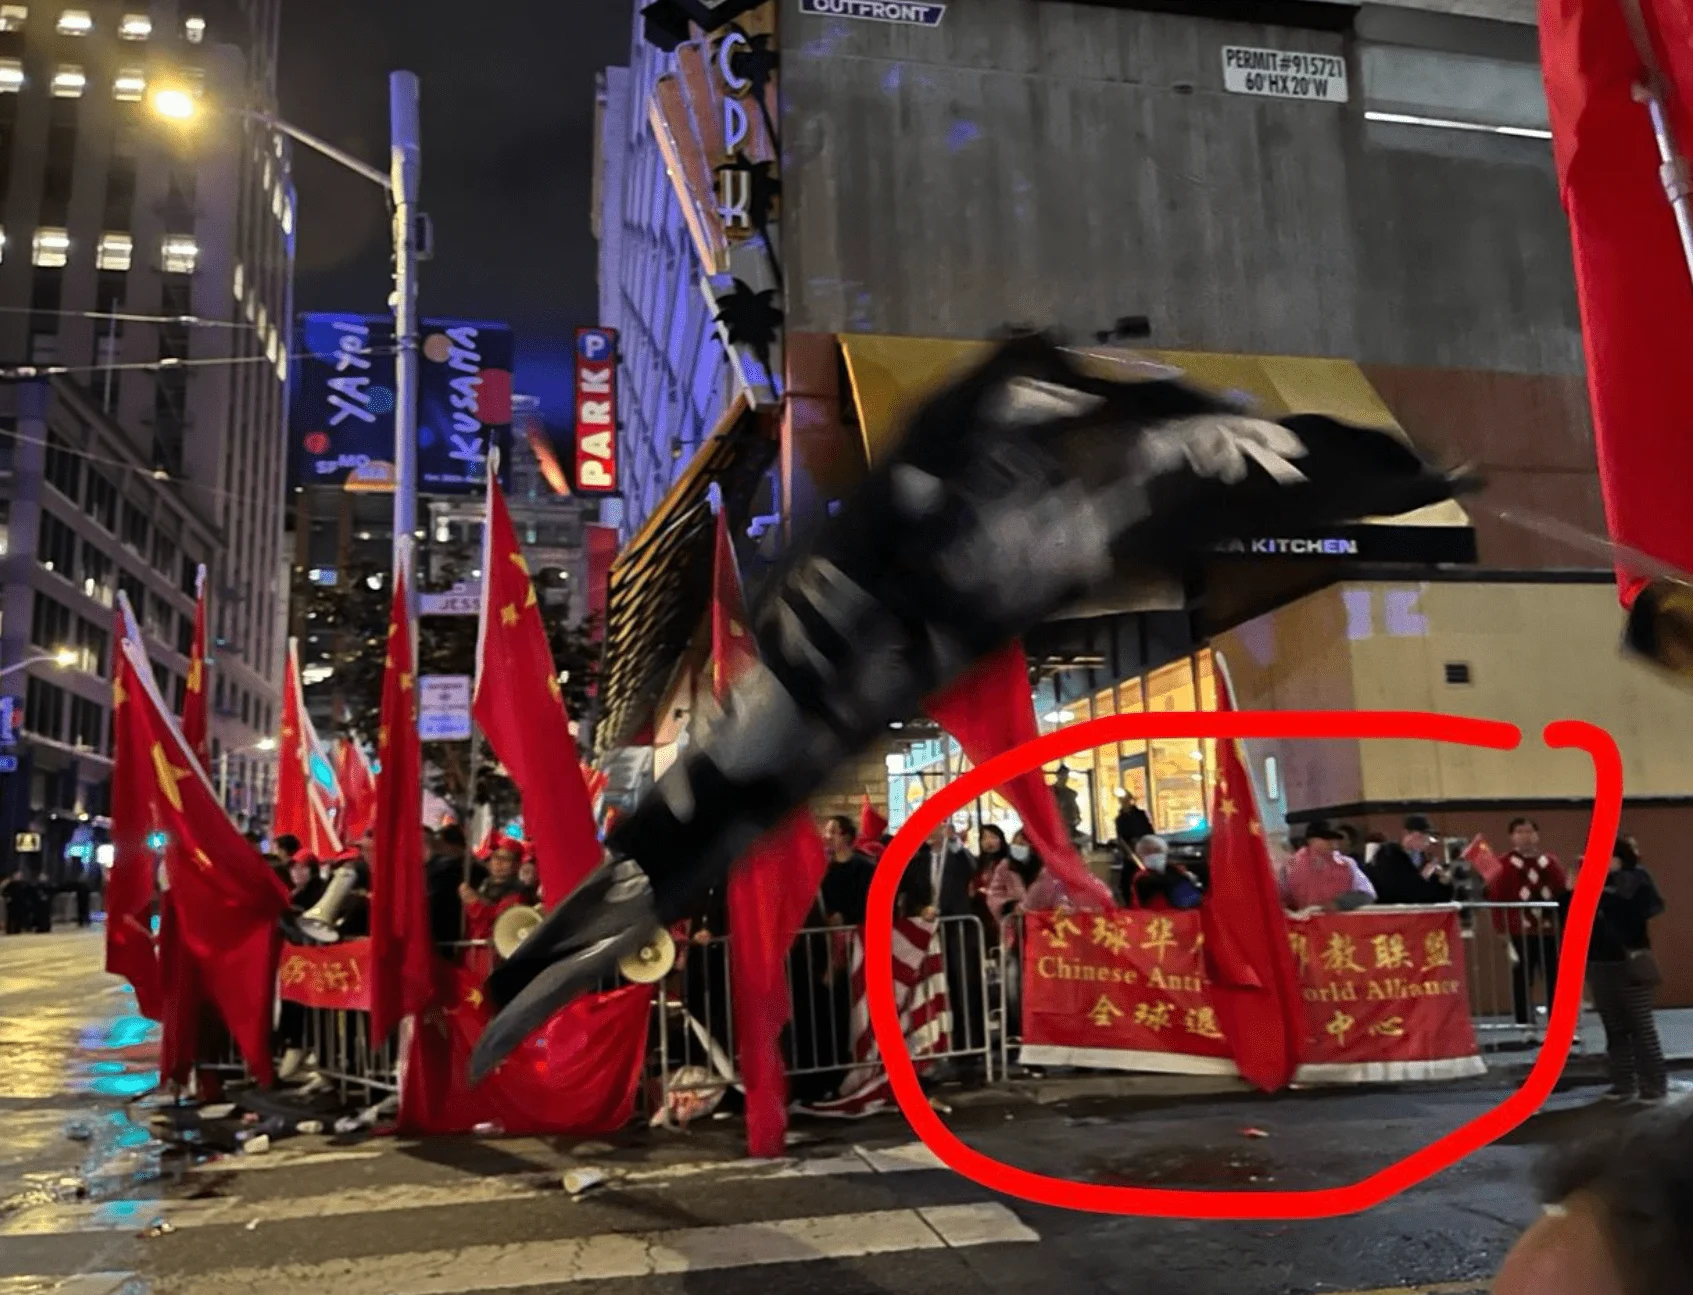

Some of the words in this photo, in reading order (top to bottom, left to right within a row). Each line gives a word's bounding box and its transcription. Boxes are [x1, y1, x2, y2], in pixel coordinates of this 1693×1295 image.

[813, 0, 930, 22] OUTFRONT
[585, 333, 605, 358] P
[446, 326, 487, 462] KUSAMA
[580, 367, 613, 487] PARK
[1251, 538, 1358, 553] KITCHEN
[1037, 955, 1138, 984] Chinese
[1302, 980, 1357, 1002] orld
[1366, 977, 1460, 1001] Alliance
